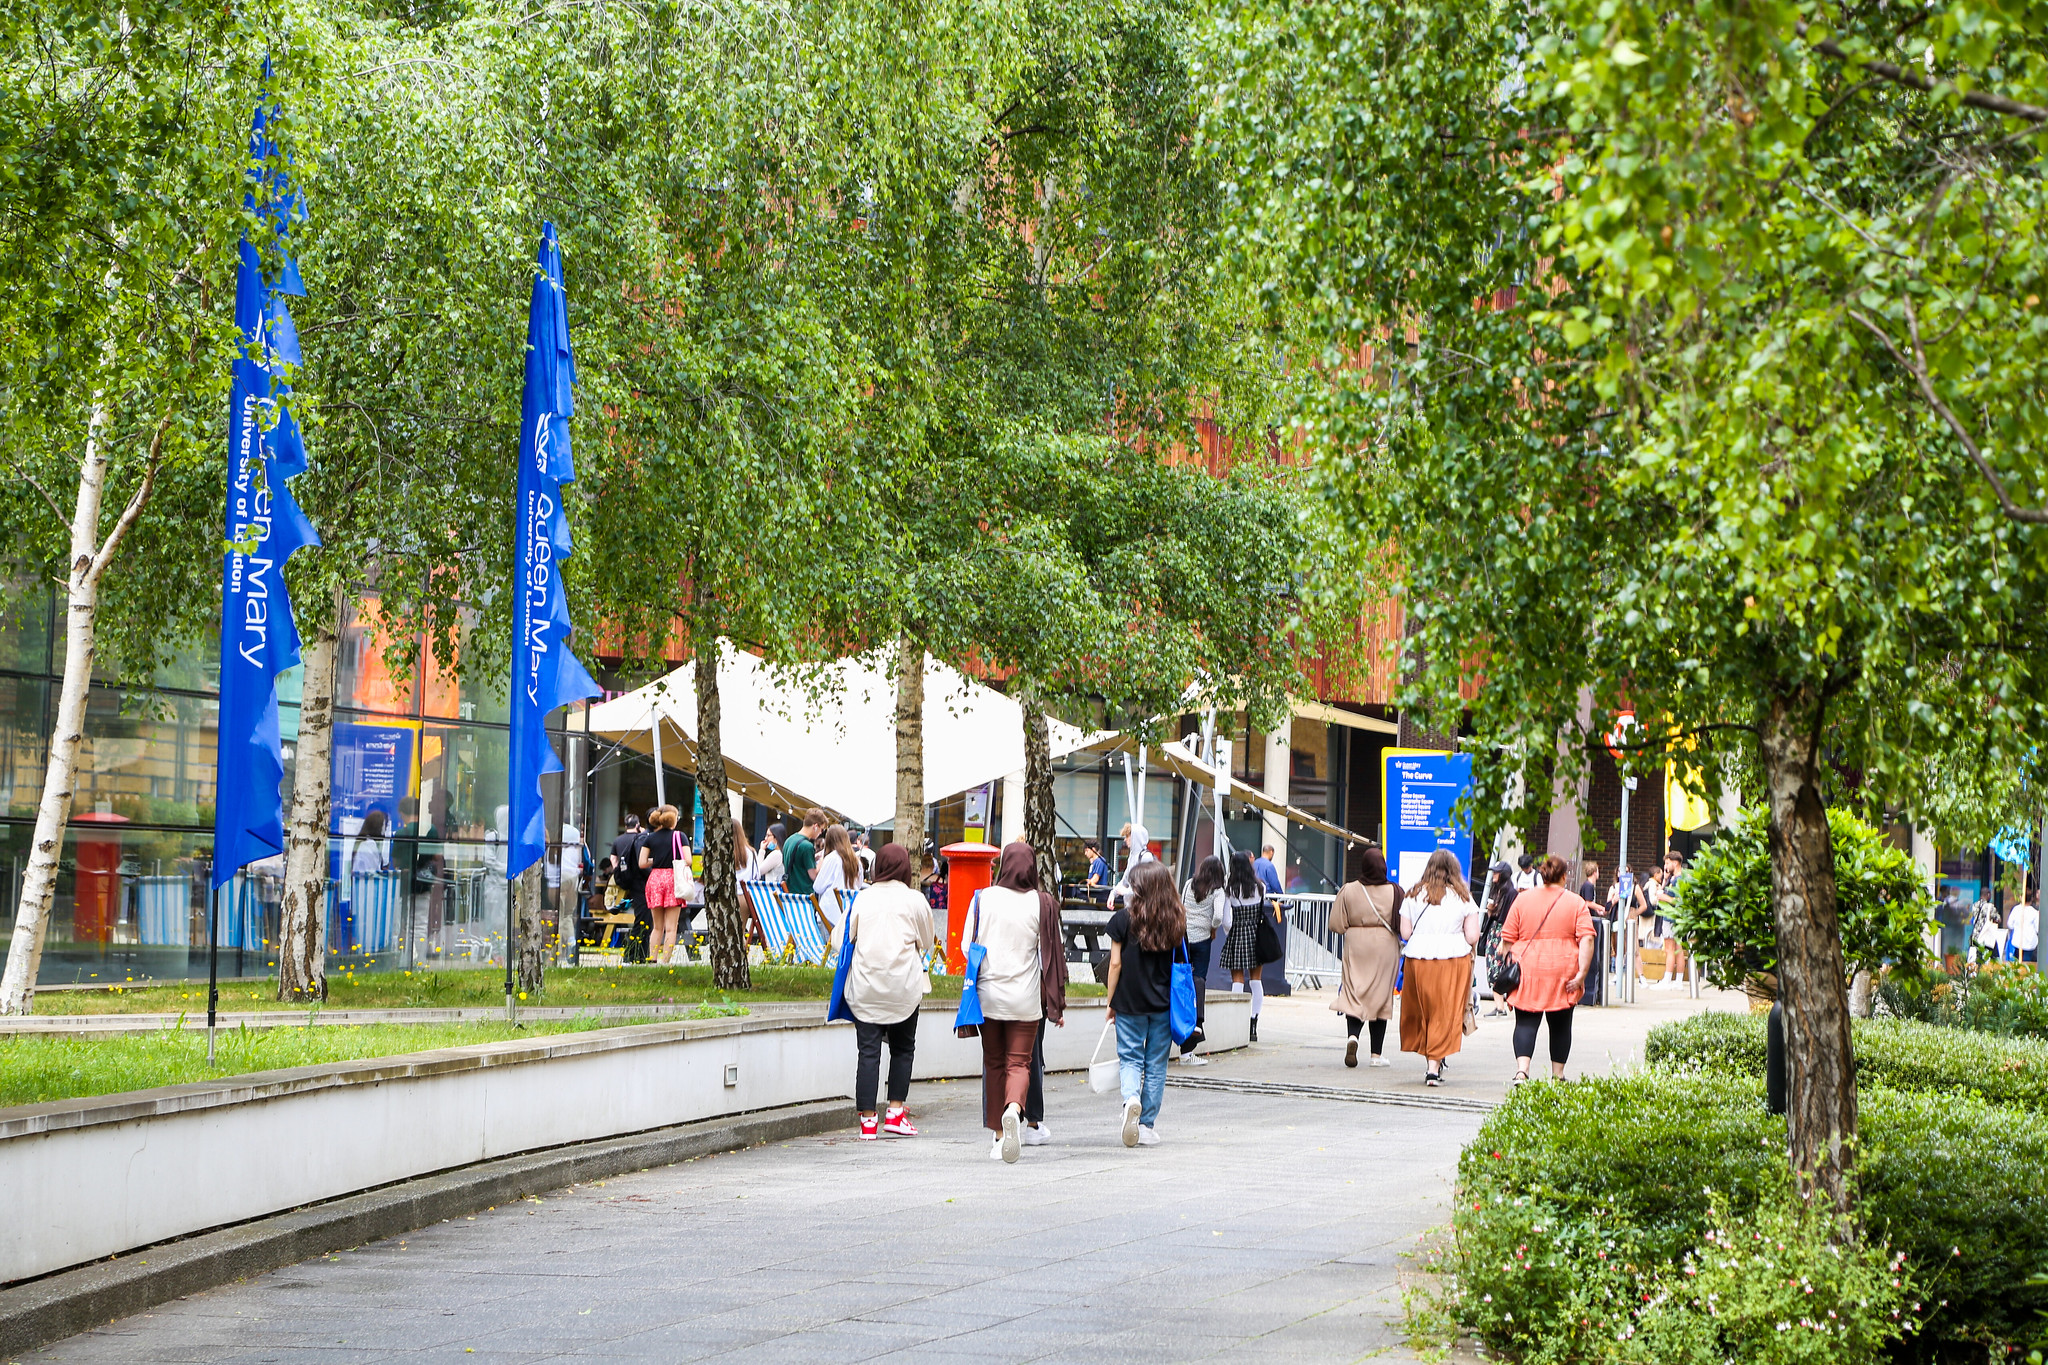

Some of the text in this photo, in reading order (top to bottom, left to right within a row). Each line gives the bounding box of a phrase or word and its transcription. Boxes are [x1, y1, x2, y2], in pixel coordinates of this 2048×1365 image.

[234, 394, 256, 493] University
[236, 497, 248, 518] of
[239, 557, 273, 669] Mary
[524, 490, 535, 647] University of London
[527, 492, 554, 707] Queen Mary
[1401, 771, 1433, 780] The Curve
